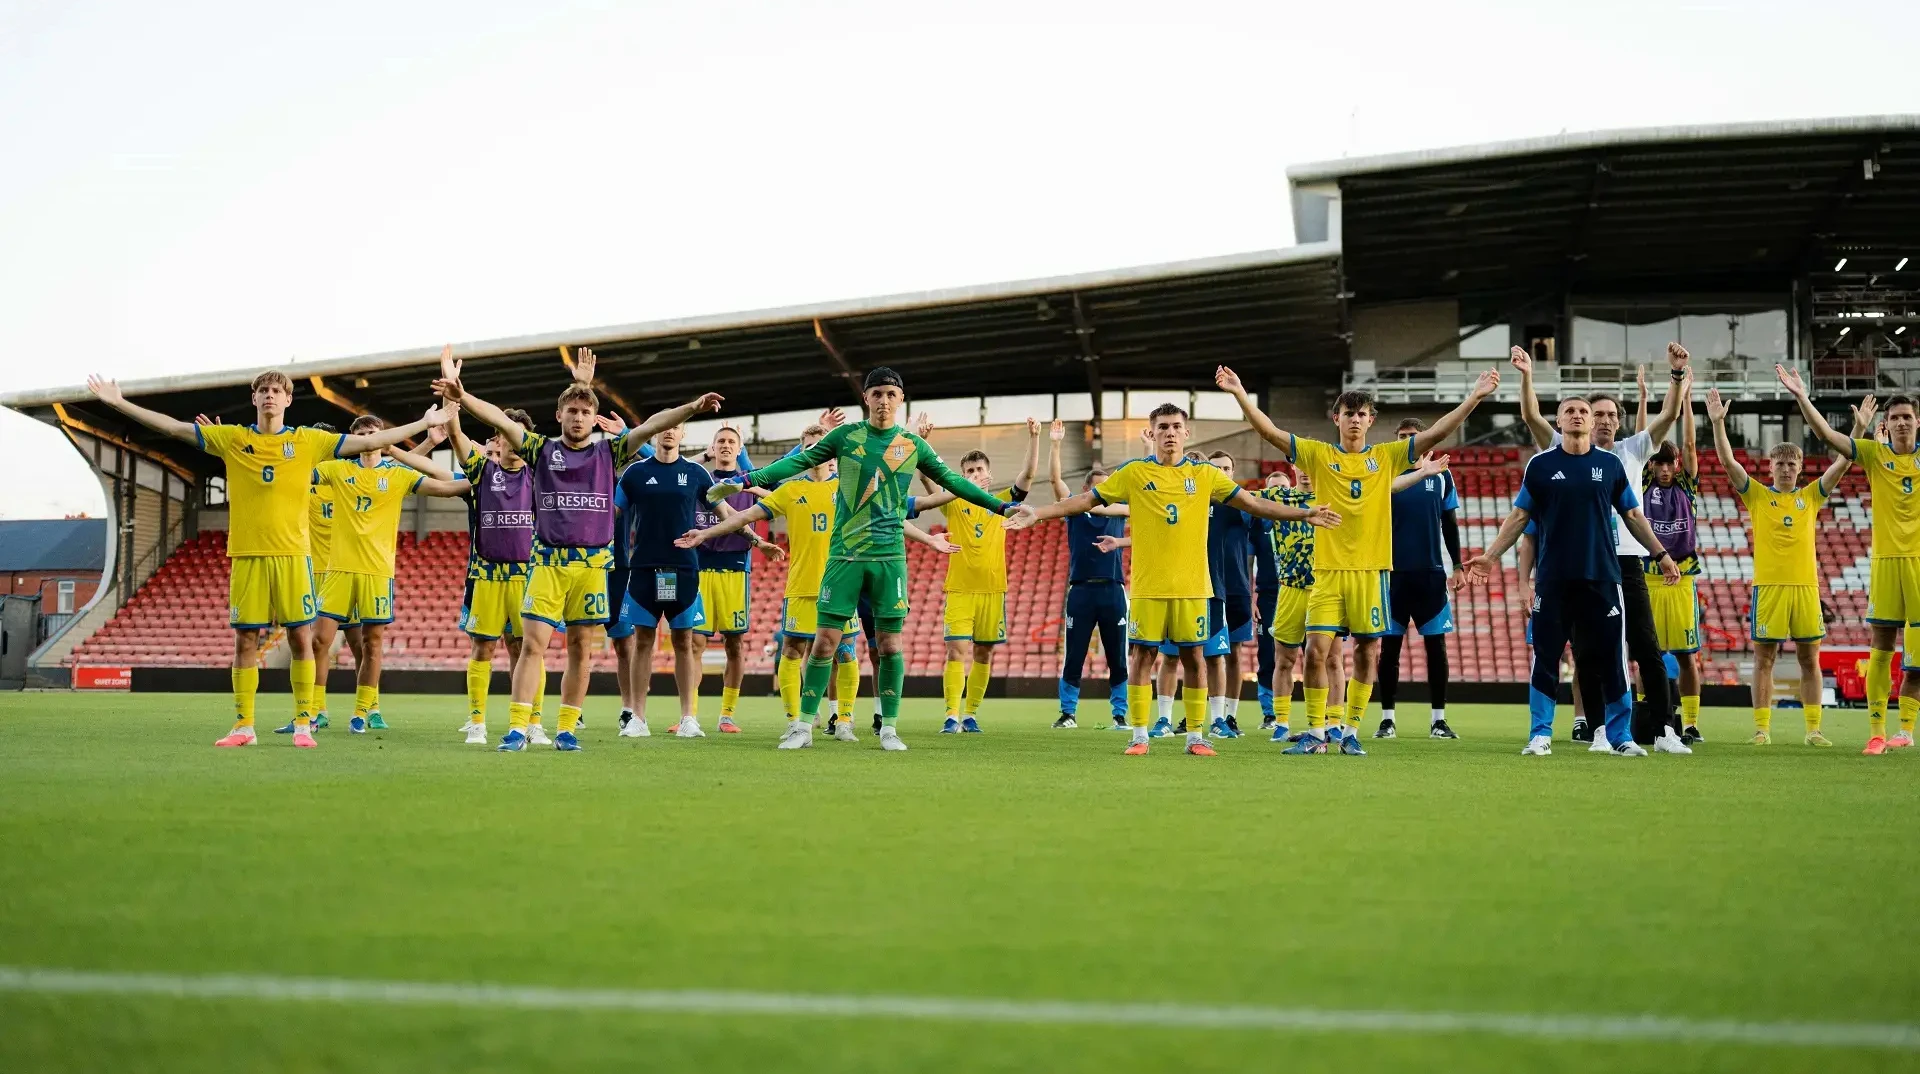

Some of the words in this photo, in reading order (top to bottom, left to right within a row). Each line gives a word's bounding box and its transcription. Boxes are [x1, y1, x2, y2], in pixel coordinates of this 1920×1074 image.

[262, 465, 274, 483] 6
[1350, 479, 1361, 499] 8
[1902, 476, 1913, 493] 9
[356, 495, 372, 512] 17
[557, 495, 607, 508] RESPECT
[496, 514, 533, 525] RESPE
[811, 513, 827, 532] 13
[1165, 504, 1178, 525] 3
[974, 524, 983, 538] 5
[1653, 521, 1687, 533] RESPECT
[897, 577, 902, 598] 1
[302, 594, 313, 615] 6
[375, 596, 388, 616] 17
[584, 593, 605, 616] 20
[733, 611, 745, 628] 15
[1370, 606, 1380, 628] 8
[1195, 616, 1205, 638] 3
